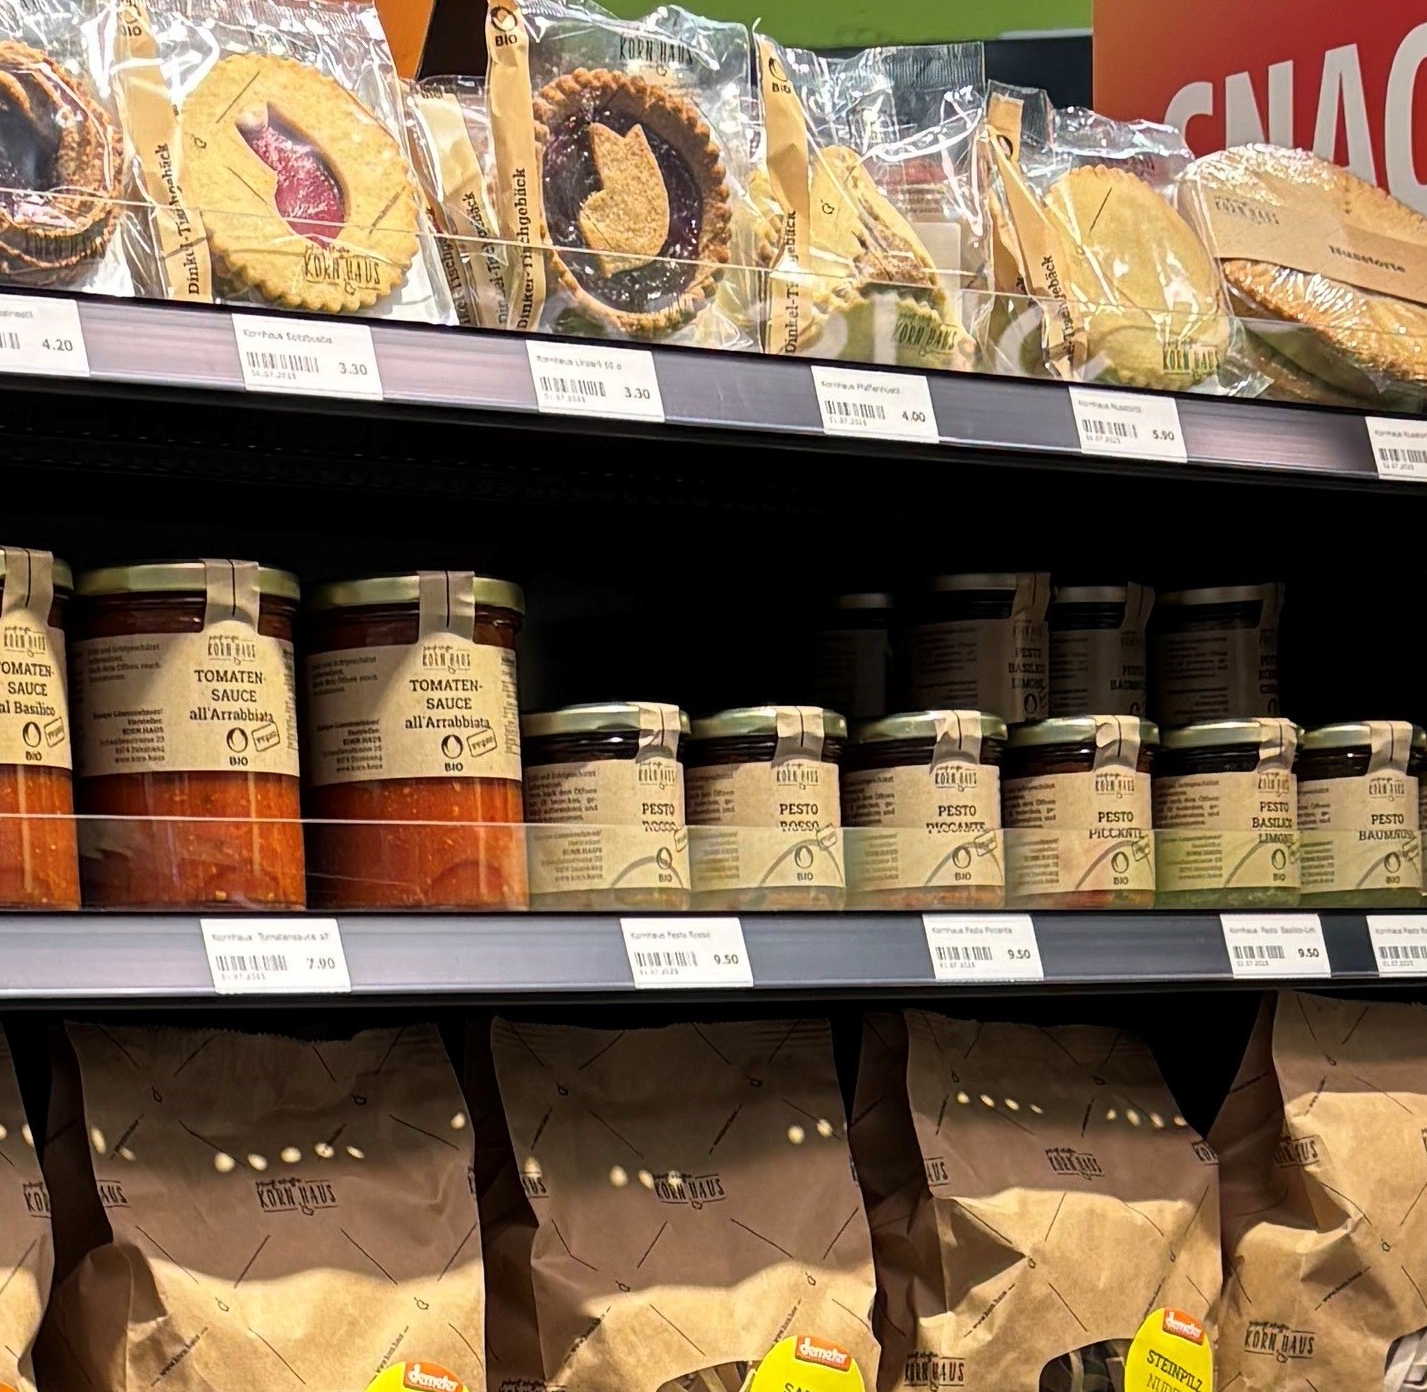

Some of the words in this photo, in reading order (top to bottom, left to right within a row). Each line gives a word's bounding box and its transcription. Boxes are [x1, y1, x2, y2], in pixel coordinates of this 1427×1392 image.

[494, 34, 518, 48] BIO
[1328, 244, 1406, 275] Nusstorte
[42, 339, 73, 351] 4.20
[339, 363, 368, 376] 3.30
[624, 387, 651, 400] 3.30
[902, 411, 926, 423] 4.00
[1153, 429, 1174, 441] 5.90
[194, 669, 266, 685] TOMATEN-
[8, 682, 48, 696] SAUCE
[409, 679, 483, 692] TOMATEN-
[211, 689, 257, 703] SAUCE
[14, 703, 55, 716] Basilico
[426, 698, 472, 710] SAUCE
[189, 705, 274, 724] all'Arrabbiata
[405, 716, 491, 730] all'Arrabbiata
[26, 752, 42, 760] BIO
[229, 756, 248, 766] BIO
[444, 762, 463, 772] BIO
[641, 803, 675, 816] PESTO
[779, 803, 819, 816] PESTO
[938, 805, 977, 817] PESTO
[1260, 801, 1289, 812] PESTO
[1098, 811, 1134, 823] PESTO
[1372, 814, 1404, 825] PESTO
[797, 872, 813, 881] BIO
[955, 872, 971, 881] BIO
[1113, 876, 1128, 885] BIO
[714, 954, 739, 965] 9.50
[1008, 949, 1031, 959] 9.50
[1298, 948, 1319, 958] 9.50
[307, 957, 335, 970] 7.90
[257, 1187, 296, 1208] KORN
[300, 1182, 337, 1205] HAUS
[653, 1180, 687, 1201] KORN
[689, 1177, 725, 1199] HAUS
[1244, 1329, 1277, 1353] KORN
[1281, 1332, 1315, 1356] HAUS
[798, 1337, 848, 1364] demeter
